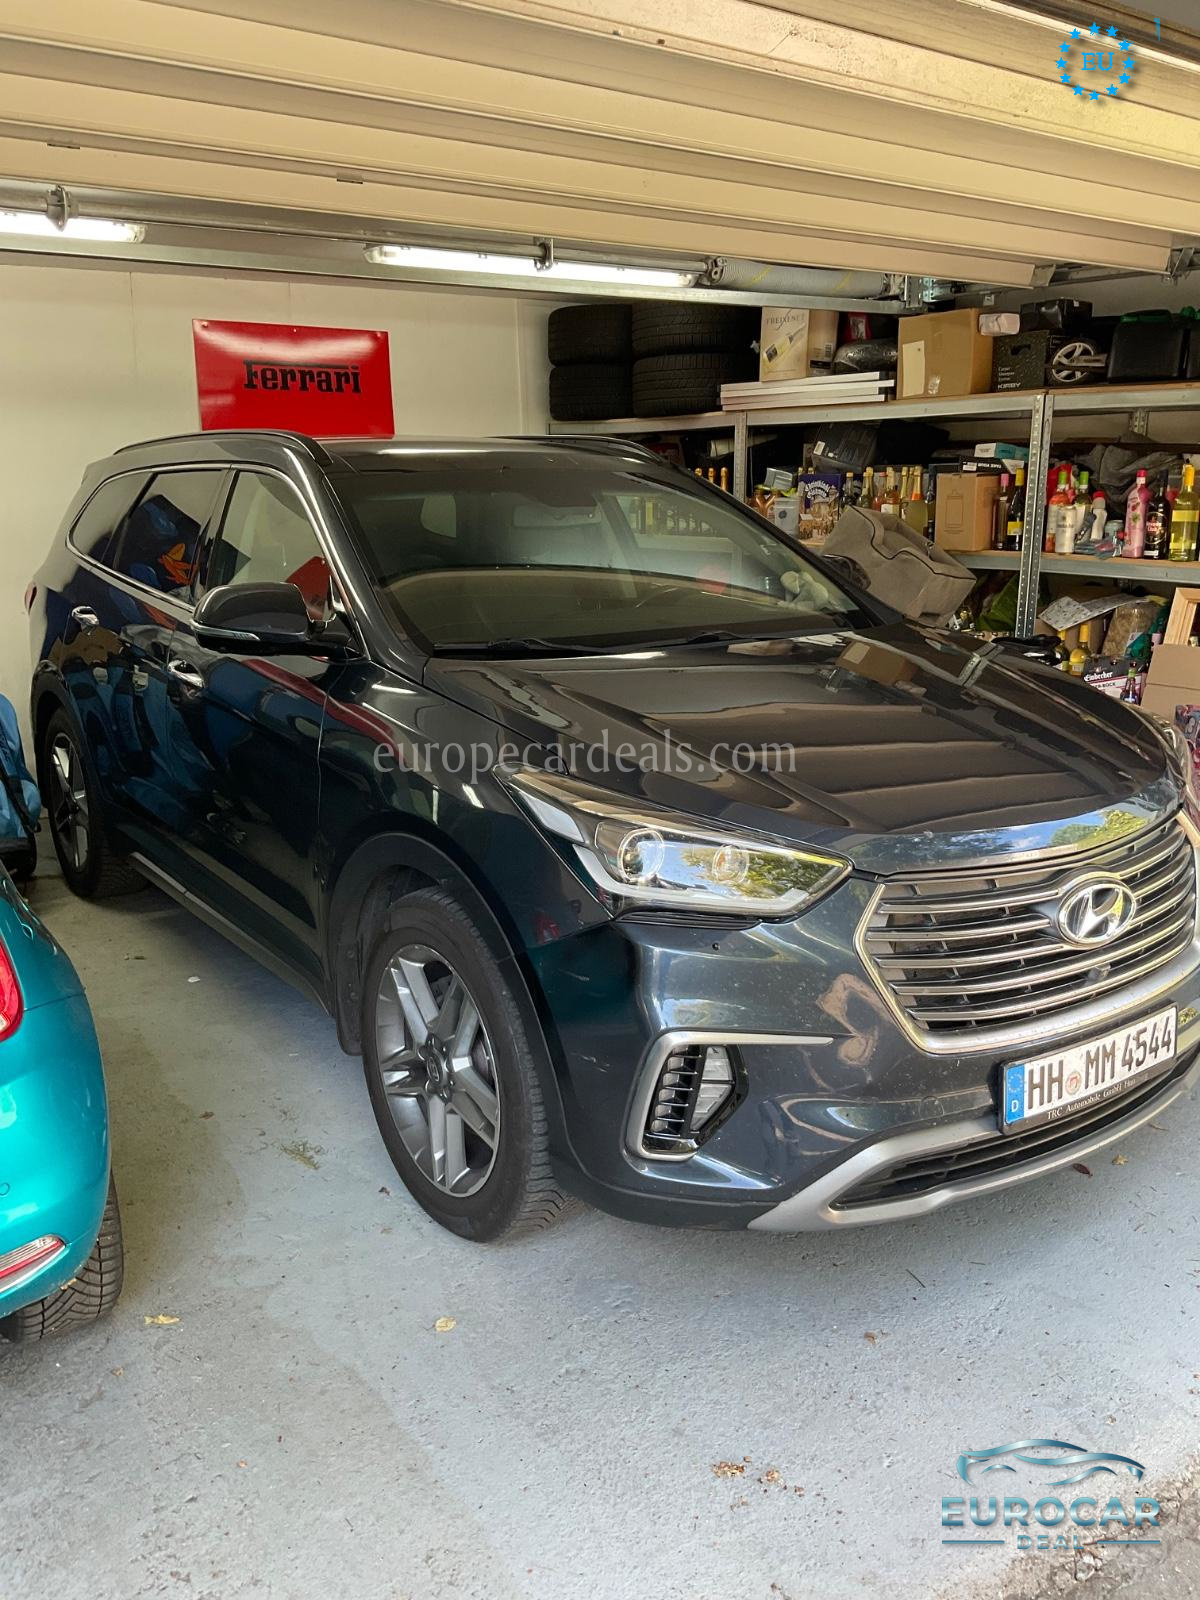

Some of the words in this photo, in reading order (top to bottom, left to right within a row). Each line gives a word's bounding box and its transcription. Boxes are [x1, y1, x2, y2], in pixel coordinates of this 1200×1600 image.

[243, 359, 362, 393] Ferrari
[997, 382, 1021, 390] KIRBY
[1011, 1099, 1019, 1113] D
[1027, 1059, 1064, 1110] HH
[1084, 1039, 1116, 1090] MM
[1121, 1015, 1173, 1072] 4544
[1046, 1107, 1063, 1120] TRC
